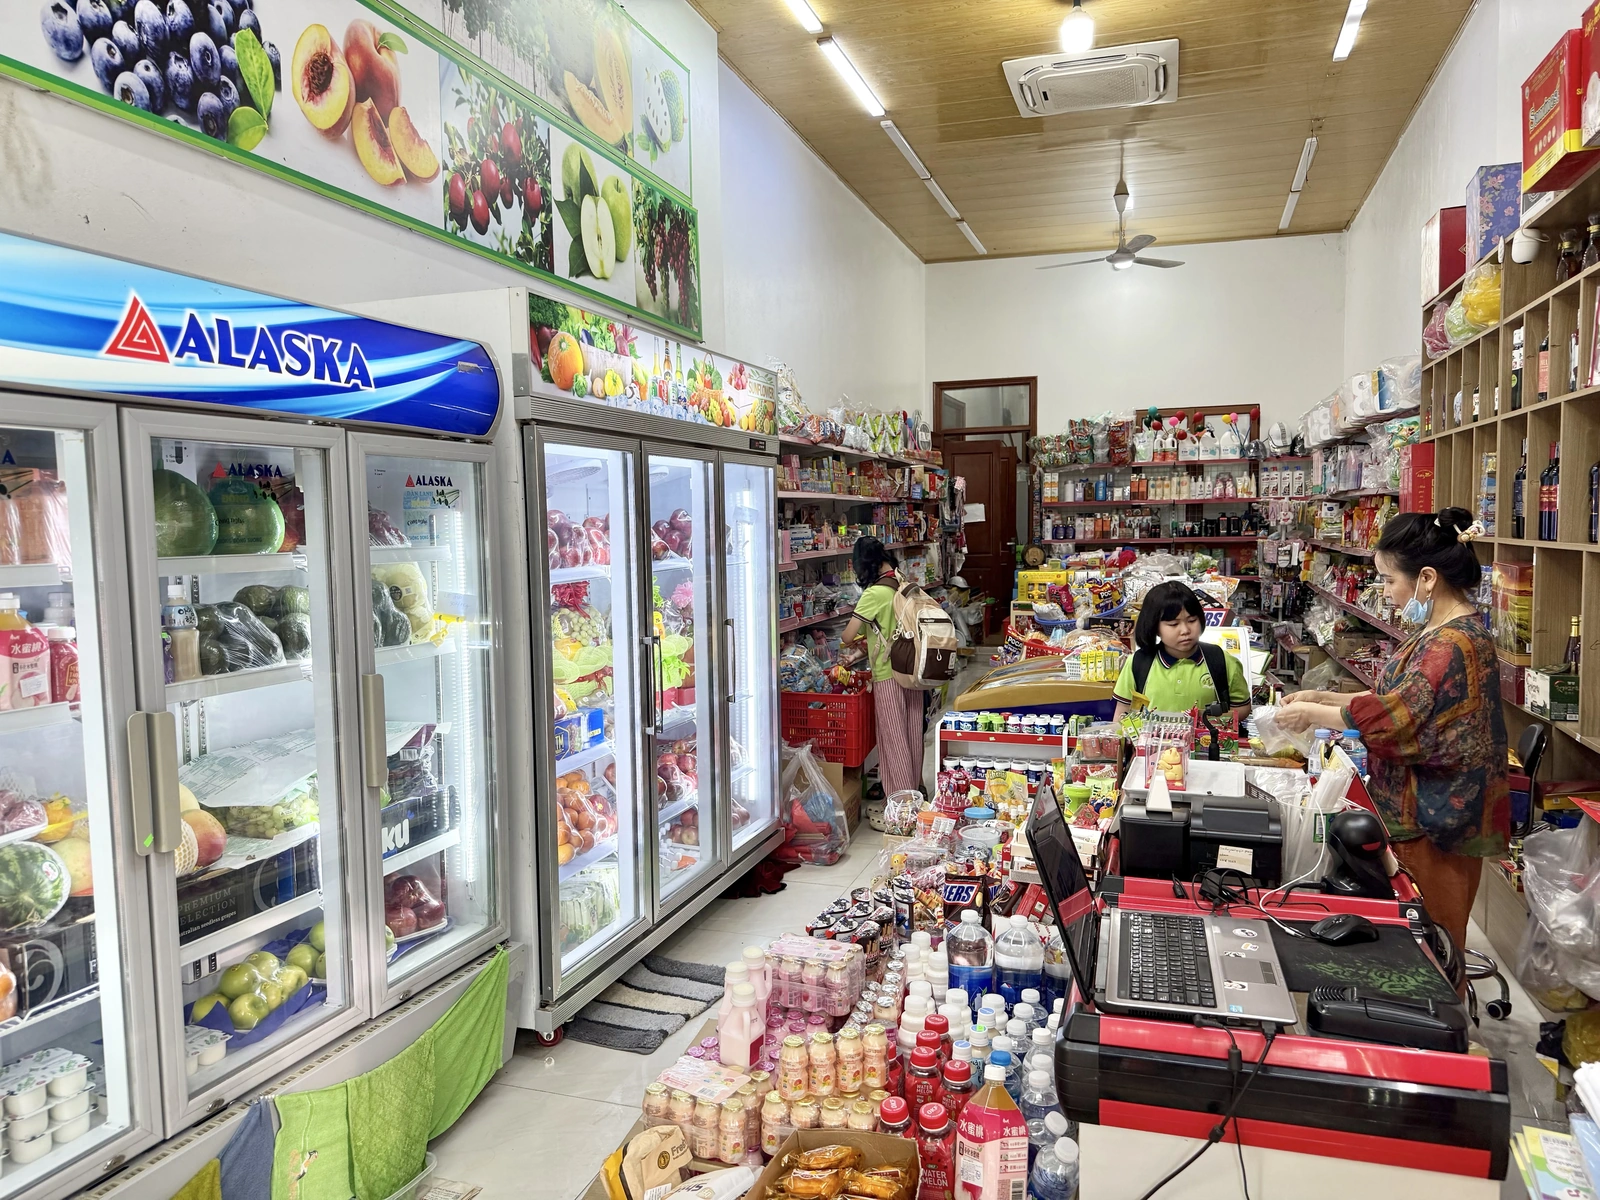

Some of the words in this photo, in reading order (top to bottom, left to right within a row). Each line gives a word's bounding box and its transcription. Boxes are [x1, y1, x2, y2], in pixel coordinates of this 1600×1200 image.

[174, 312, 374, 389] ALASKA
[748, 380, 775, 399] SUNFLOWER
[228, 463, 283, 478] ALASKA
[415, 475, 453, 487] ALASKA
[11, 642, 41, 655] 水蜜桃
[178, 887, 232, 914] PREMIUM
[201, 917, 221, 929] seedless
[221, 910, 237, 922] grapes
[942, 1097, 957, 1106] WATER
[942, 1101, 957, 1110] MELON
[926, 1104, 938, 1115] OKF
[959, 1118, 984, 1140] 水蜜桃
[1003, 1125, 1027, 1137] 水蜜桃
[921, 1169, 947, 1180] WATER
[921, 1177, 948, 1187] MELON
